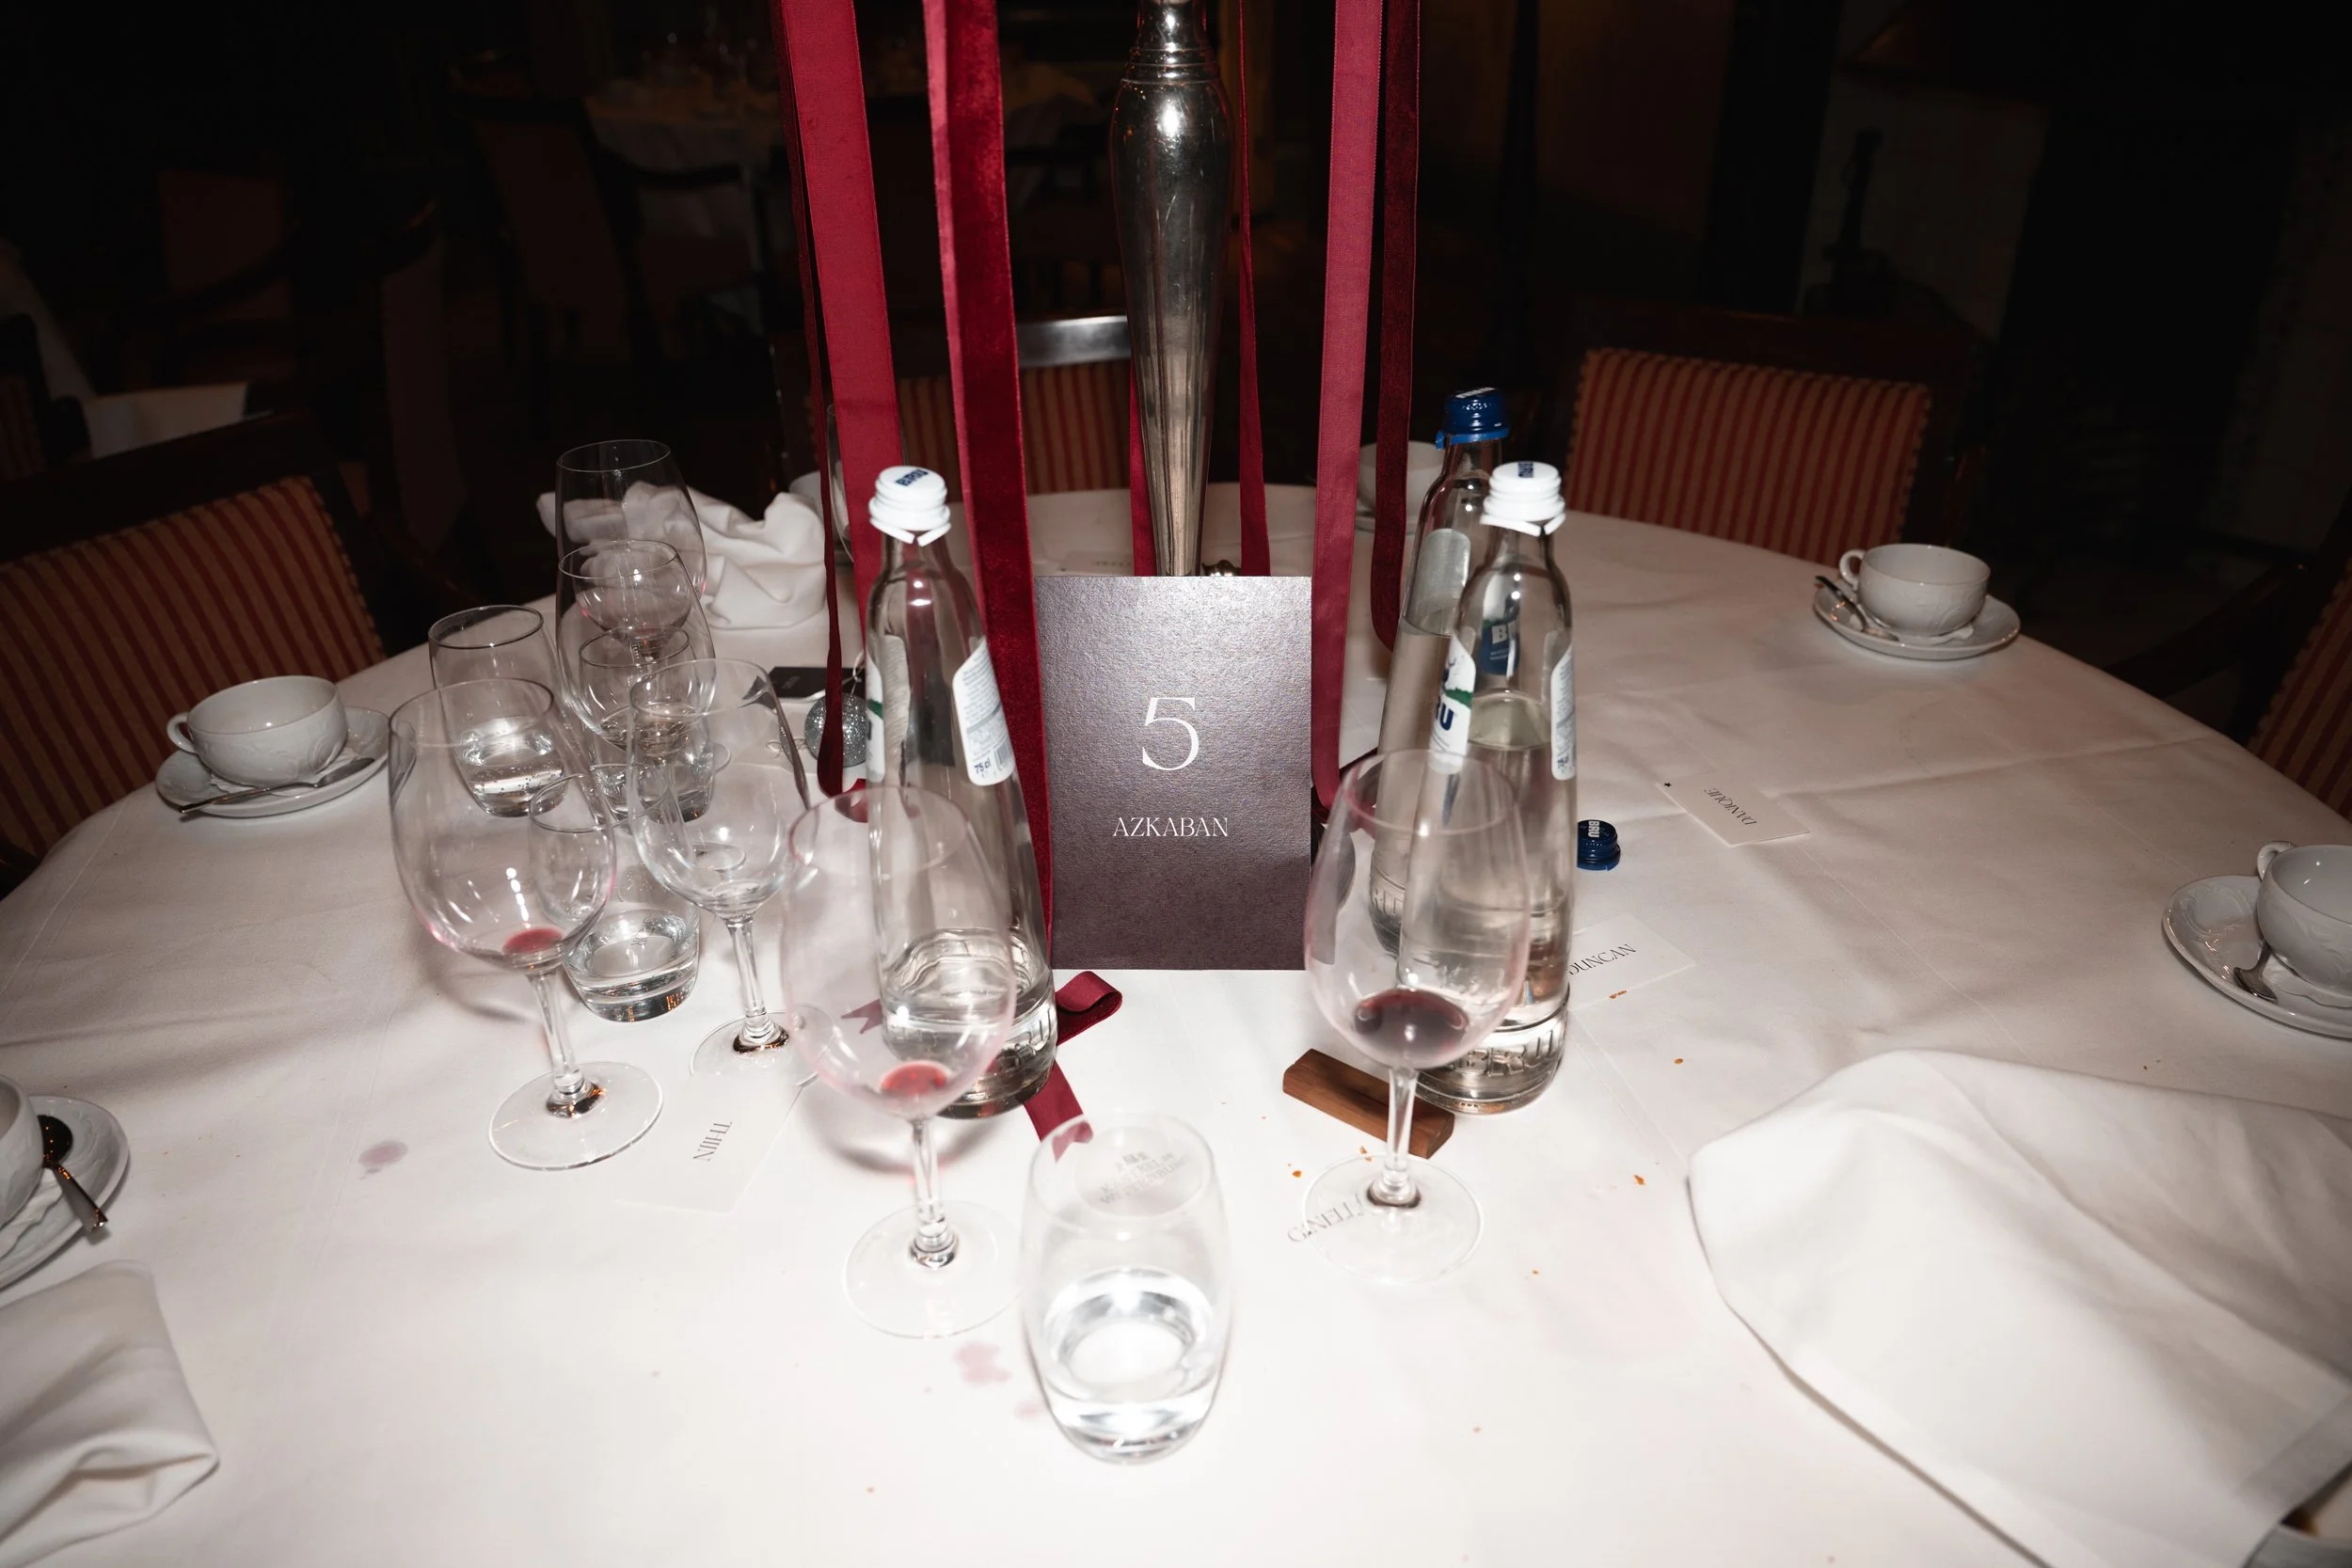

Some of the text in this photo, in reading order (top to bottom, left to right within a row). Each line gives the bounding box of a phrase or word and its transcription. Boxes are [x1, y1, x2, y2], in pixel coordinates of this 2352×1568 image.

[1142, 697, 1200, 770] 5
[1113, 817, 1229, 837] AZKABAN
[1588, 820, 1600, 838] BRU
[1568, 943, 1637, 975] DUNCAN
